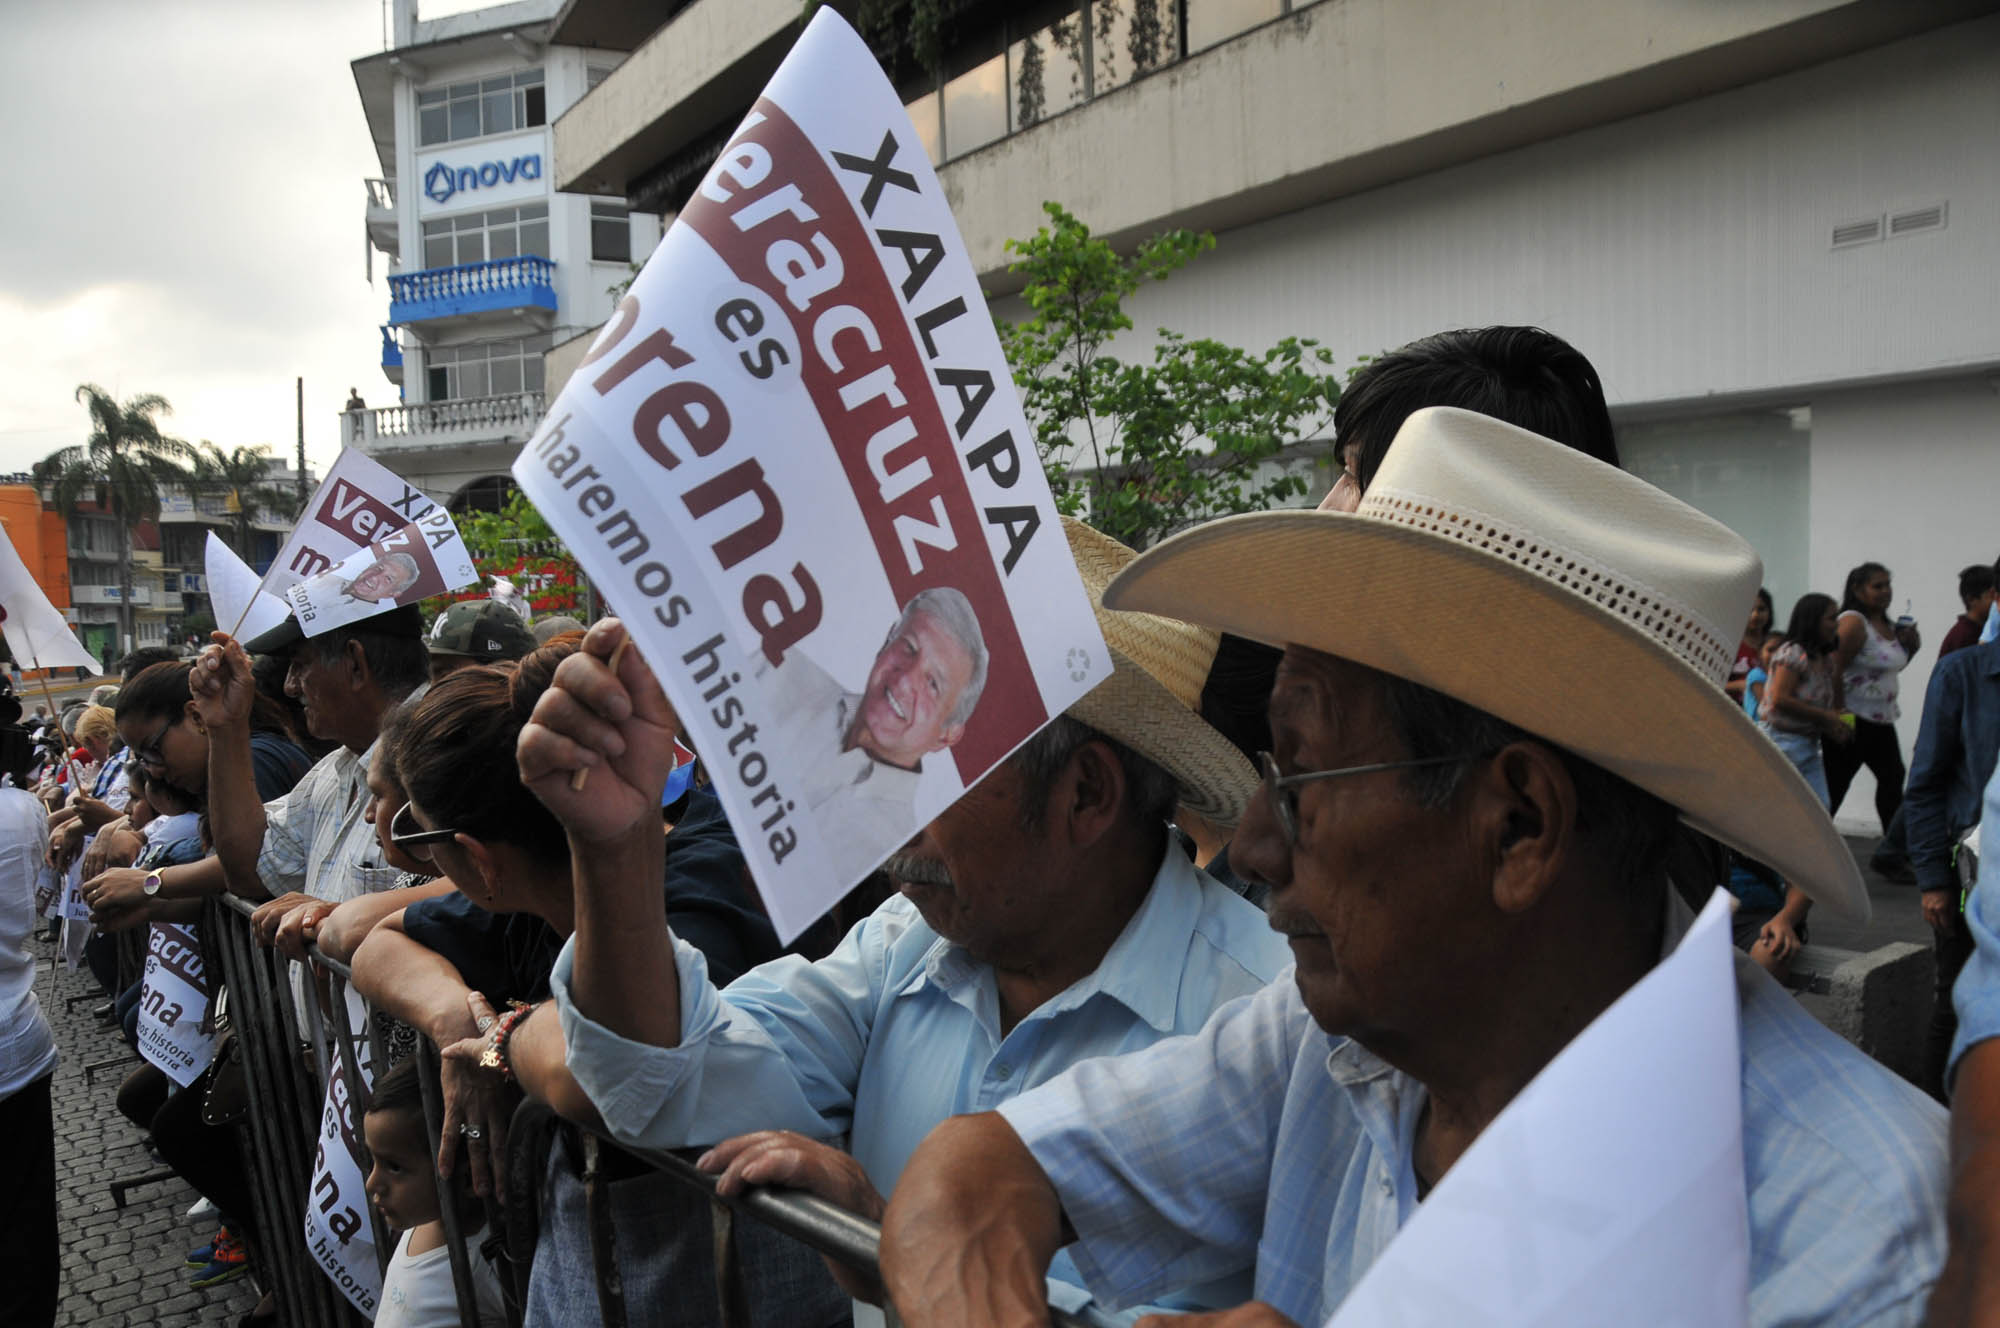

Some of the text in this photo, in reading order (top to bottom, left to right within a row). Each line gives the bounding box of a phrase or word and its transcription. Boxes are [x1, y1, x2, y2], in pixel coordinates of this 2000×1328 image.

[457, 153, 541, 191] nova
[714, 298, 790, 380] es
[831, 129, 1041, 577] XALAPA
[535, 413, 798, 866] haremos historia
[149, 1028, 195, 1068] historia
[314, 1236, 376, 1312] historia
